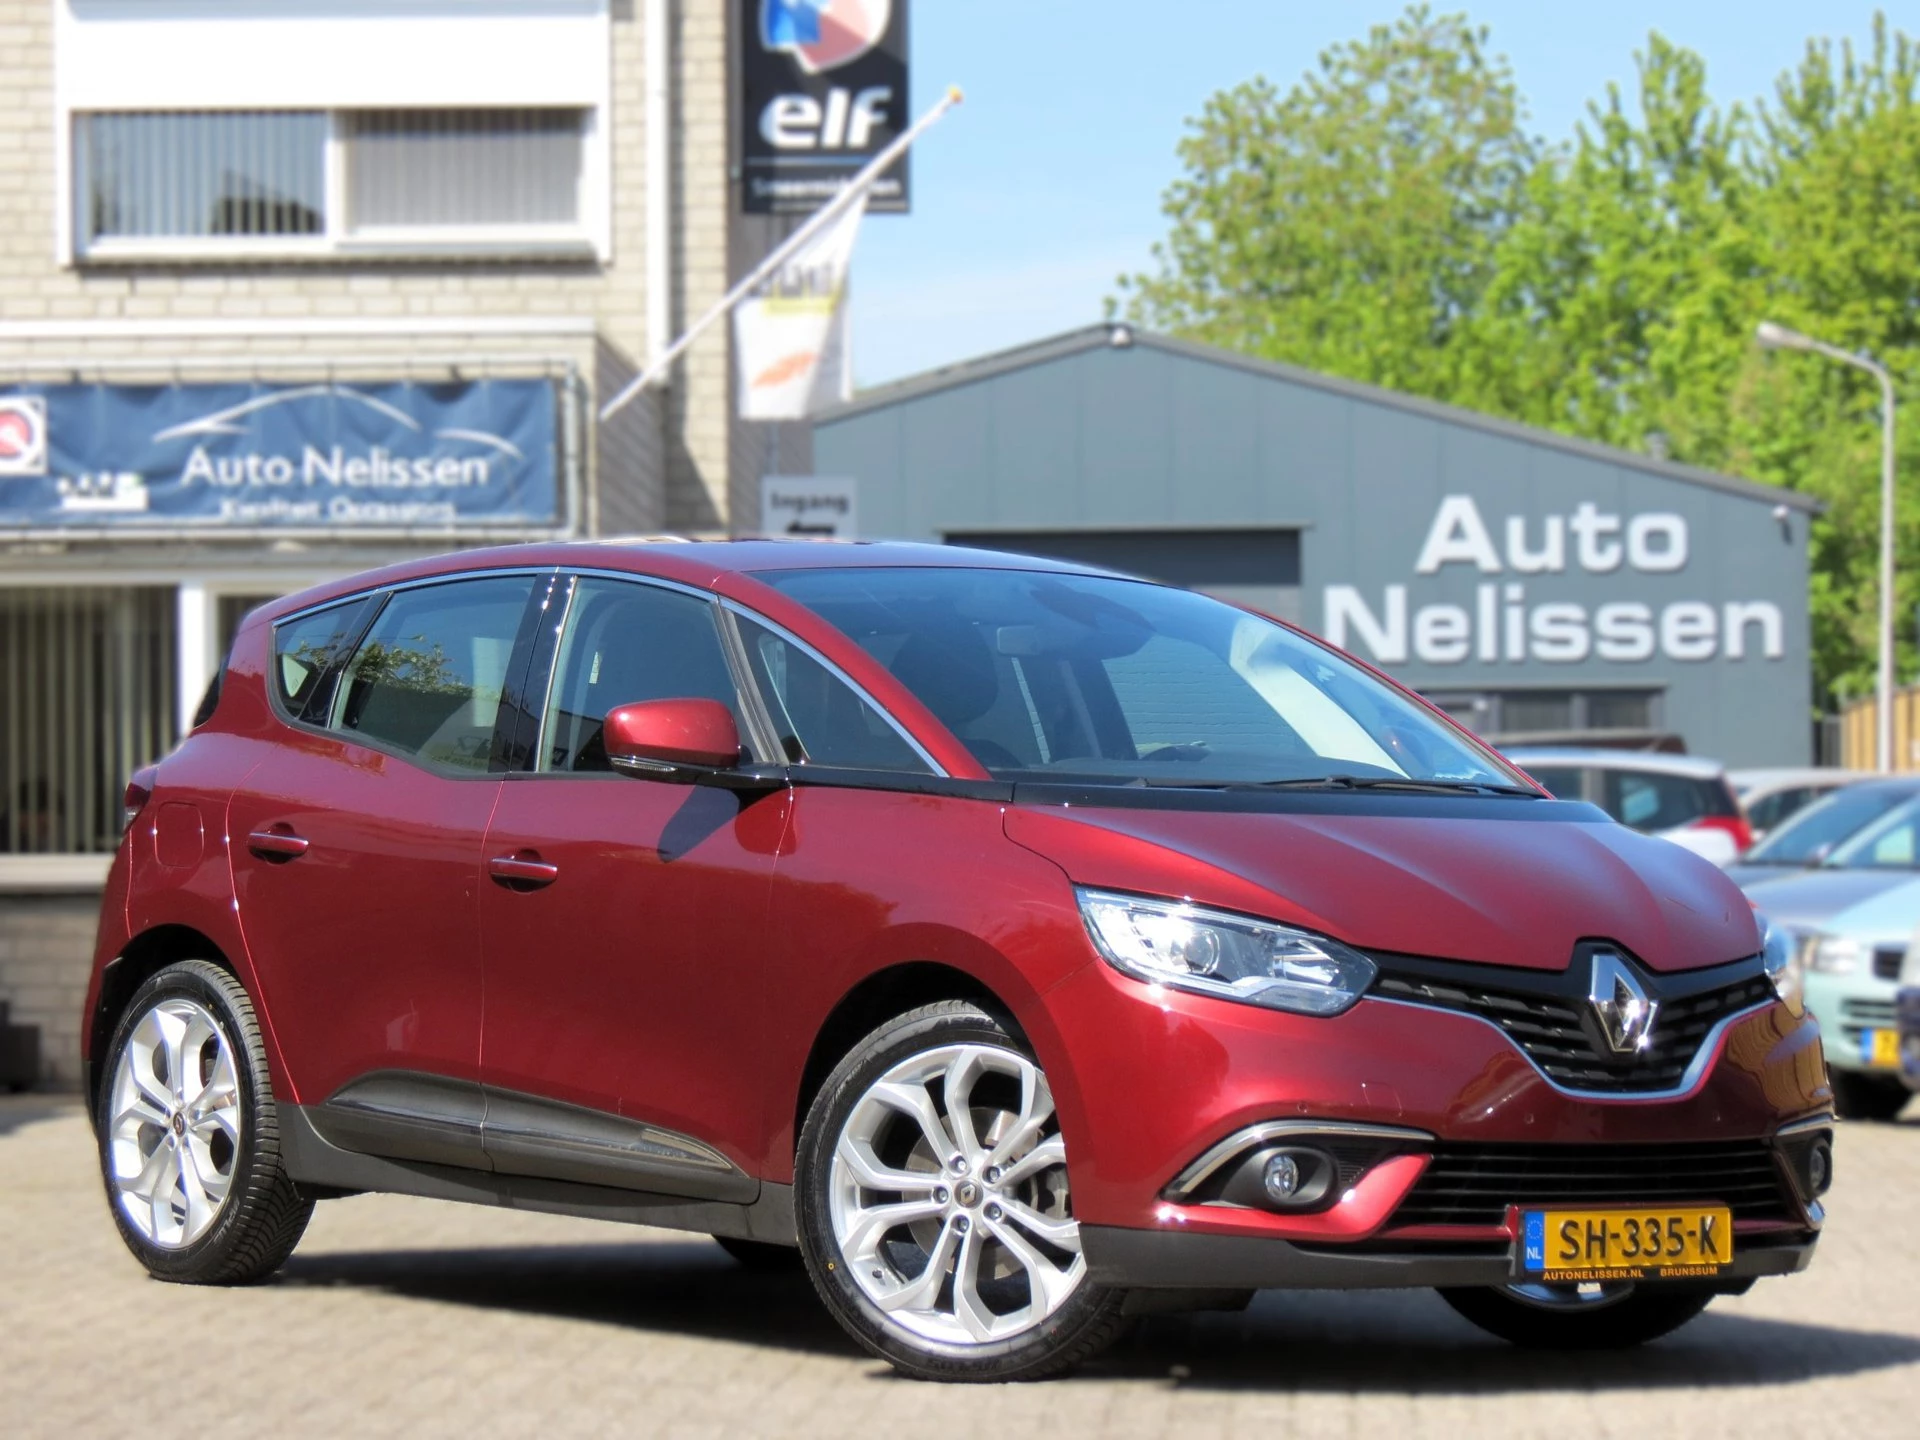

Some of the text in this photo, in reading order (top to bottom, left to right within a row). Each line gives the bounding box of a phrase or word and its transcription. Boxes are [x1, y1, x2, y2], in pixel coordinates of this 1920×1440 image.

[758, 86, 892, 148] elf
[181, 445, 490, 487] Auto Nelissen
[1414, 494, 1688, 574] Auto
[1323, 583, 1783, 663] Nelissen
[1526, 1246, 1542, 1260] NL
[1558, 1215, 1719, 1261] SH-335-K
[1543, 1266, 1718, 1281] AUTONELISSEN.NL BRUNSSUM
